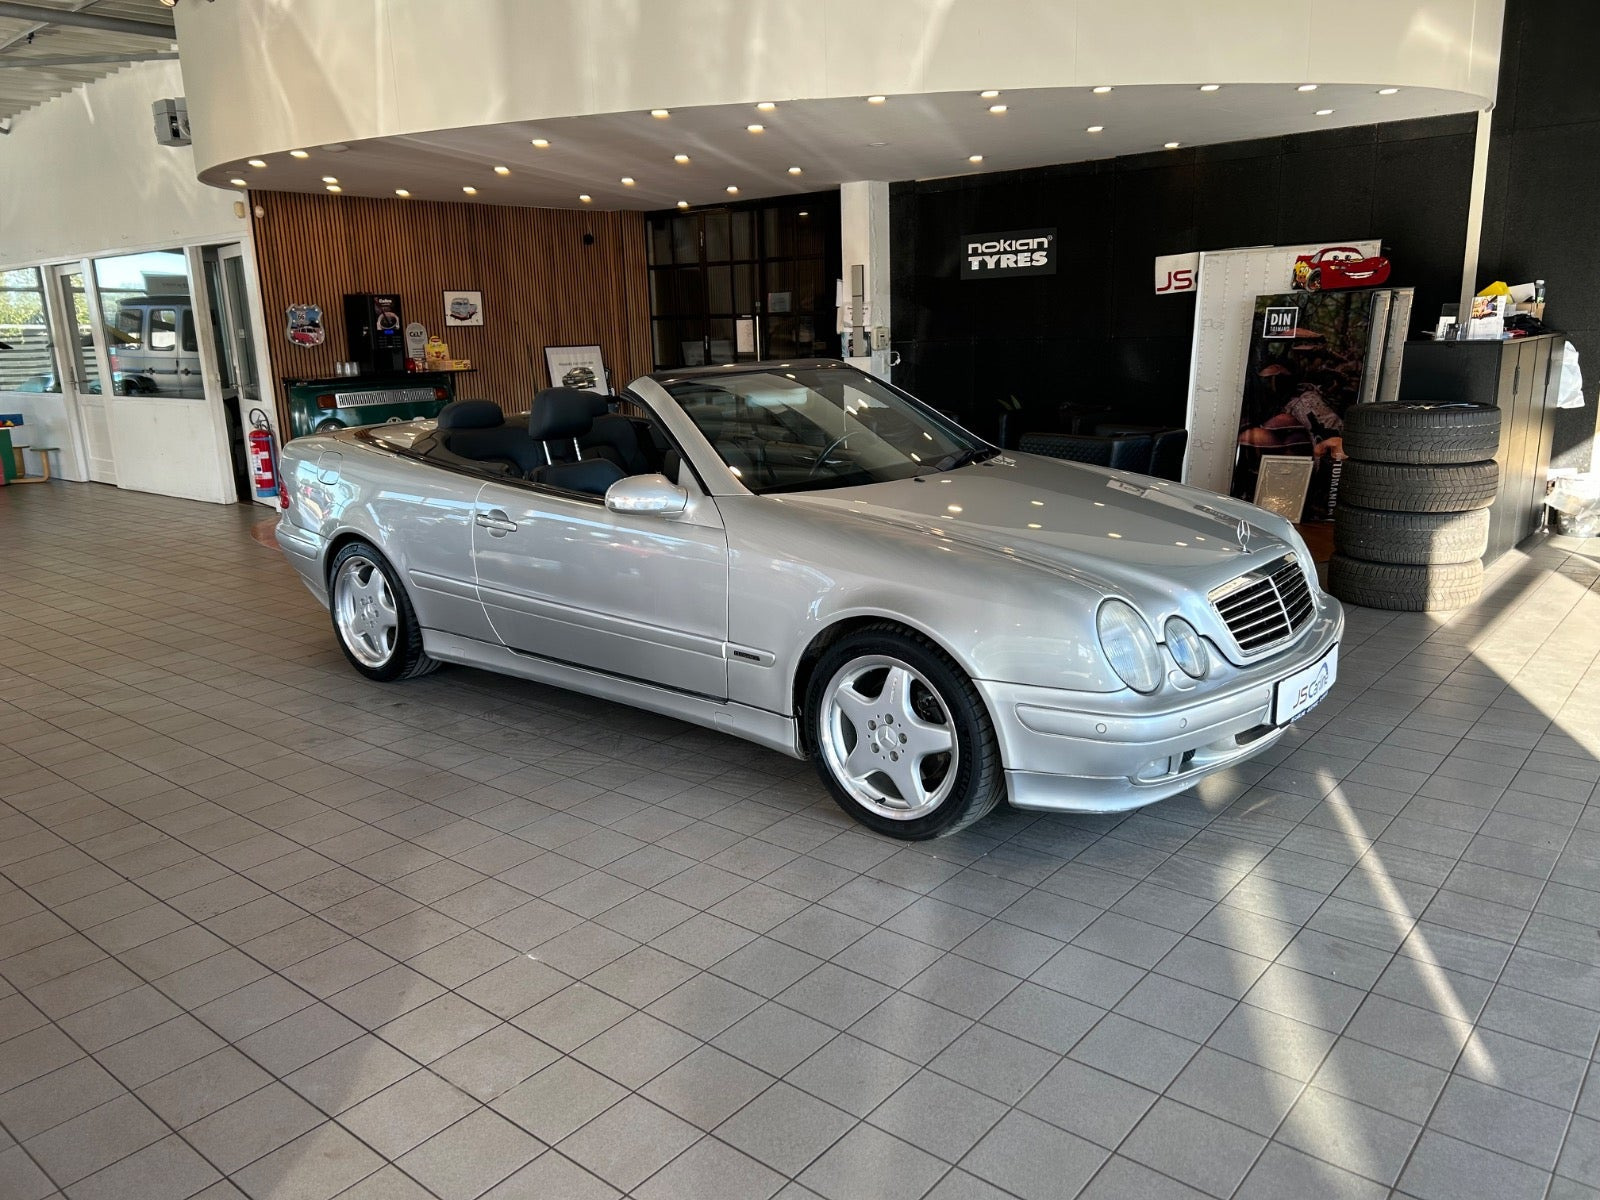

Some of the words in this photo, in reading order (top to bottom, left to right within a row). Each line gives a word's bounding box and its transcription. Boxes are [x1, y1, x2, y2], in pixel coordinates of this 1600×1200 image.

[968, 251, 1048, 270] TYRES
[1157, 269, 1198, 292] JS
[1270, 313, 1292, 326] DIN
